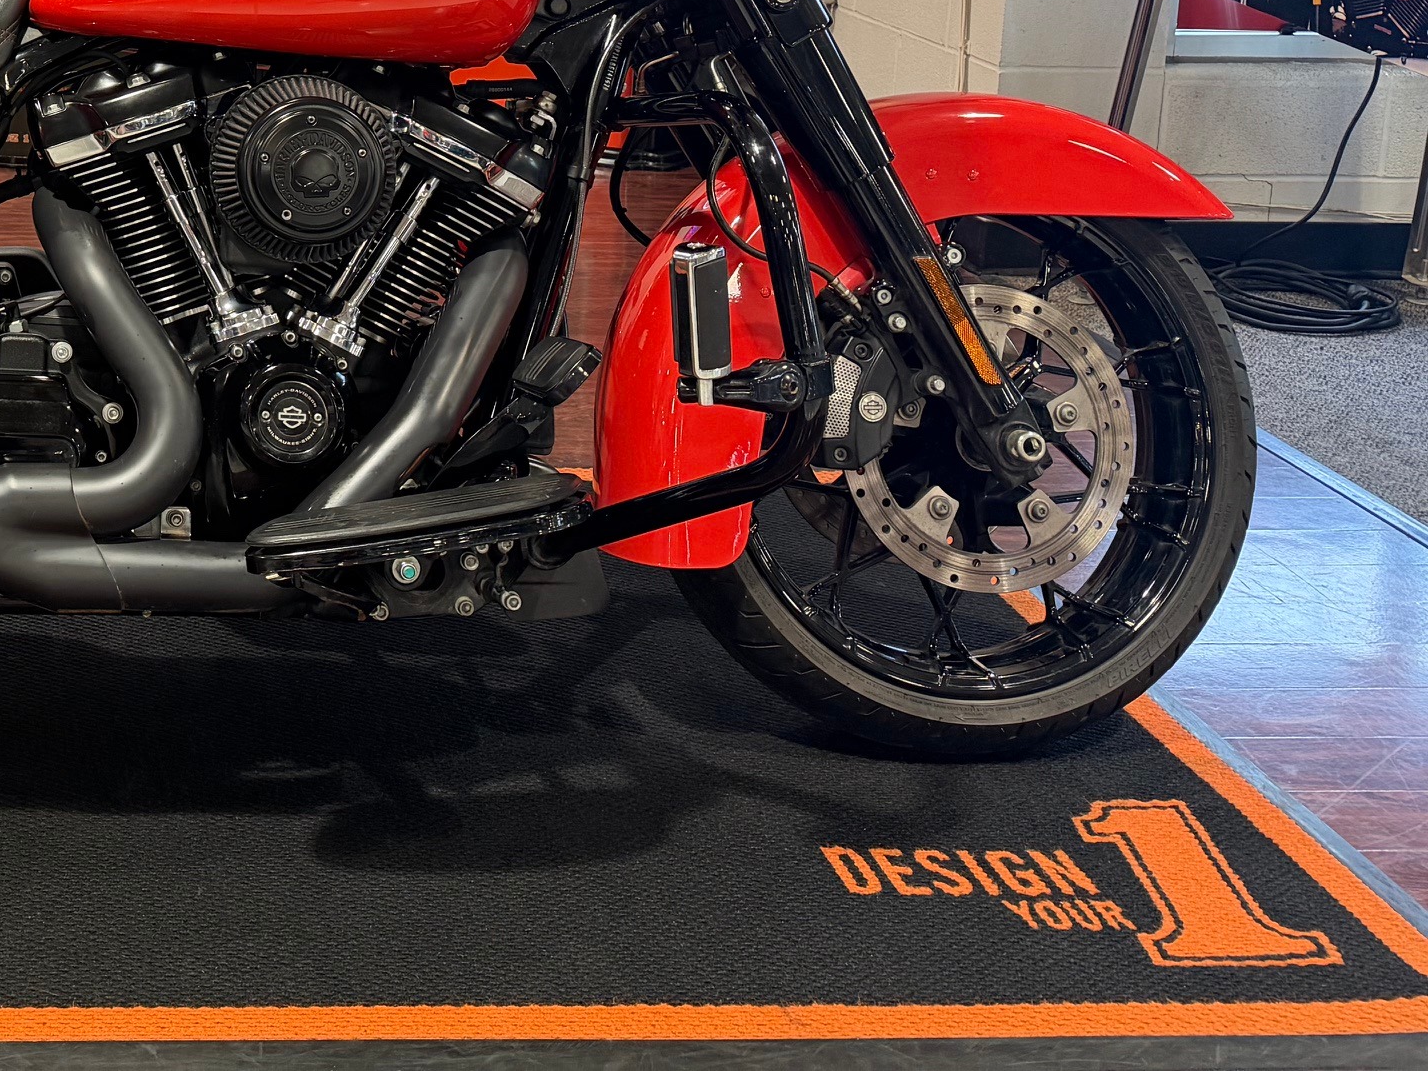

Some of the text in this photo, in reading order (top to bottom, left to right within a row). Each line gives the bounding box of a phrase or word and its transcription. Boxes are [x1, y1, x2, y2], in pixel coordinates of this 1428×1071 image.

[267, 388, 318, 408] HARLEY-DAVIDSON
[1106, 622, 1172, 689] PIRELLI
[819, 845, 1101, 897] DESIGN
[1071, 798, 1345, 967] 1
[1001, 898, 1138, 931] YOUR
